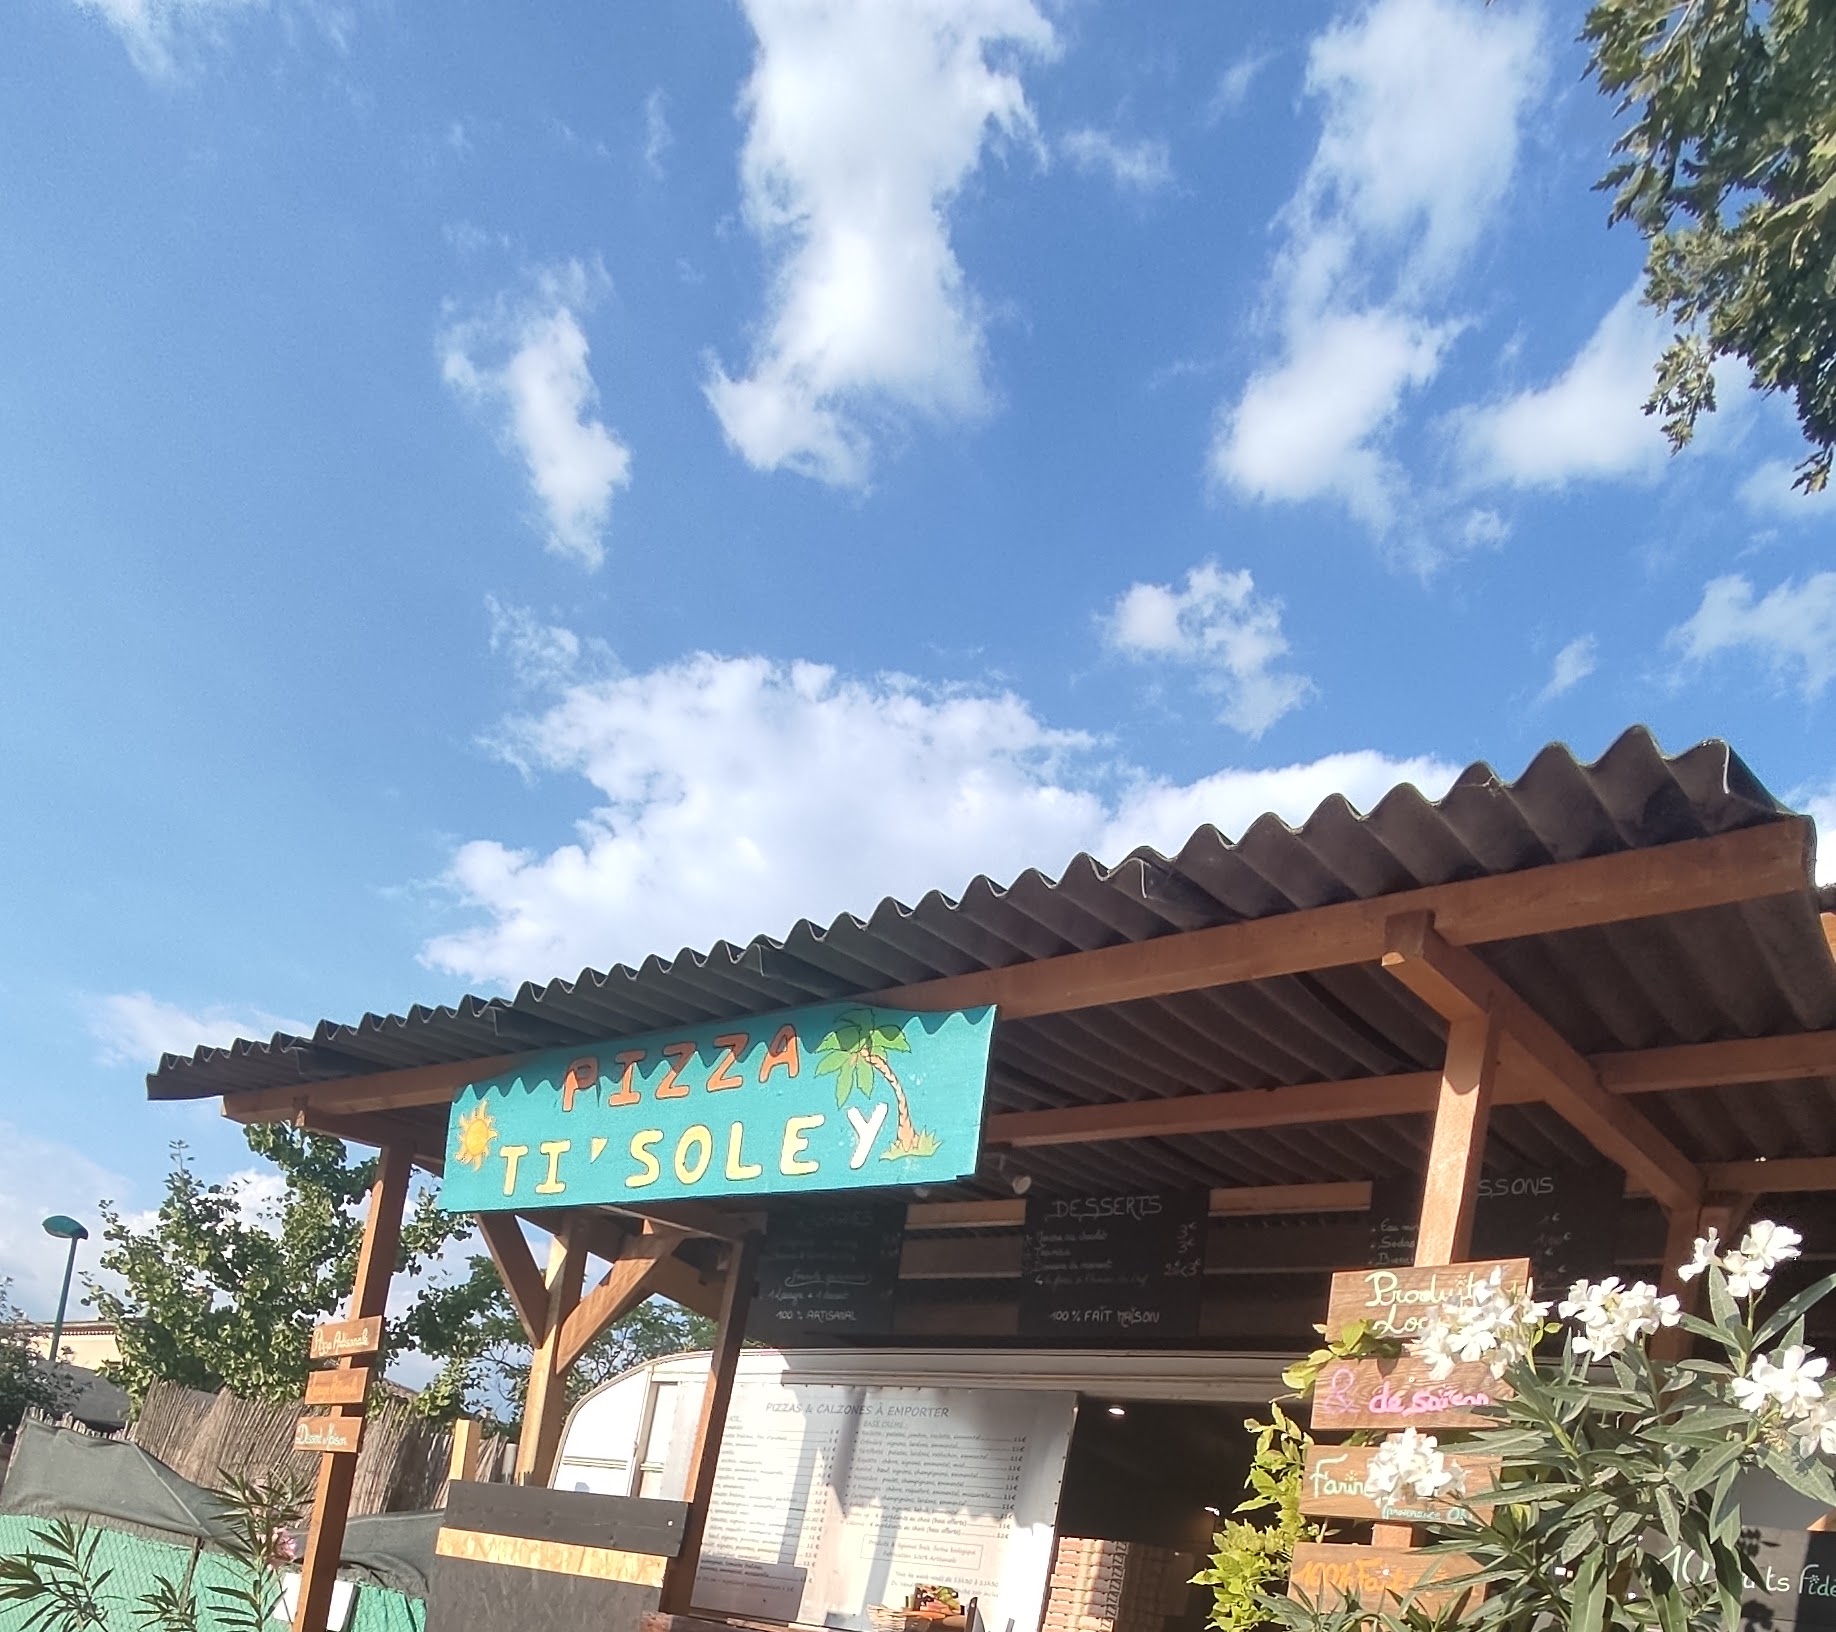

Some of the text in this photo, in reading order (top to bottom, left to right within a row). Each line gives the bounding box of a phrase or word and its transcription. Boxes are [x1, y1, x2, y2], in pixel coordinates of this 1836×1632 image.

[562, 1023, 800, 1112] PIZZA
[1478, 1176, 1554, 1199] SSONS
[1045, 1195, 1163, 1221] DESSERTS
[1364, 1271, 1478, 1307] Produit
[1373, 1304, 1428, 1335] Loc
[766, 1402, 801, 1413] PIZZAS
[816, 1403, 871, 1415] CALZONES
[887, 1406, 949, 1419] EMPORTER
